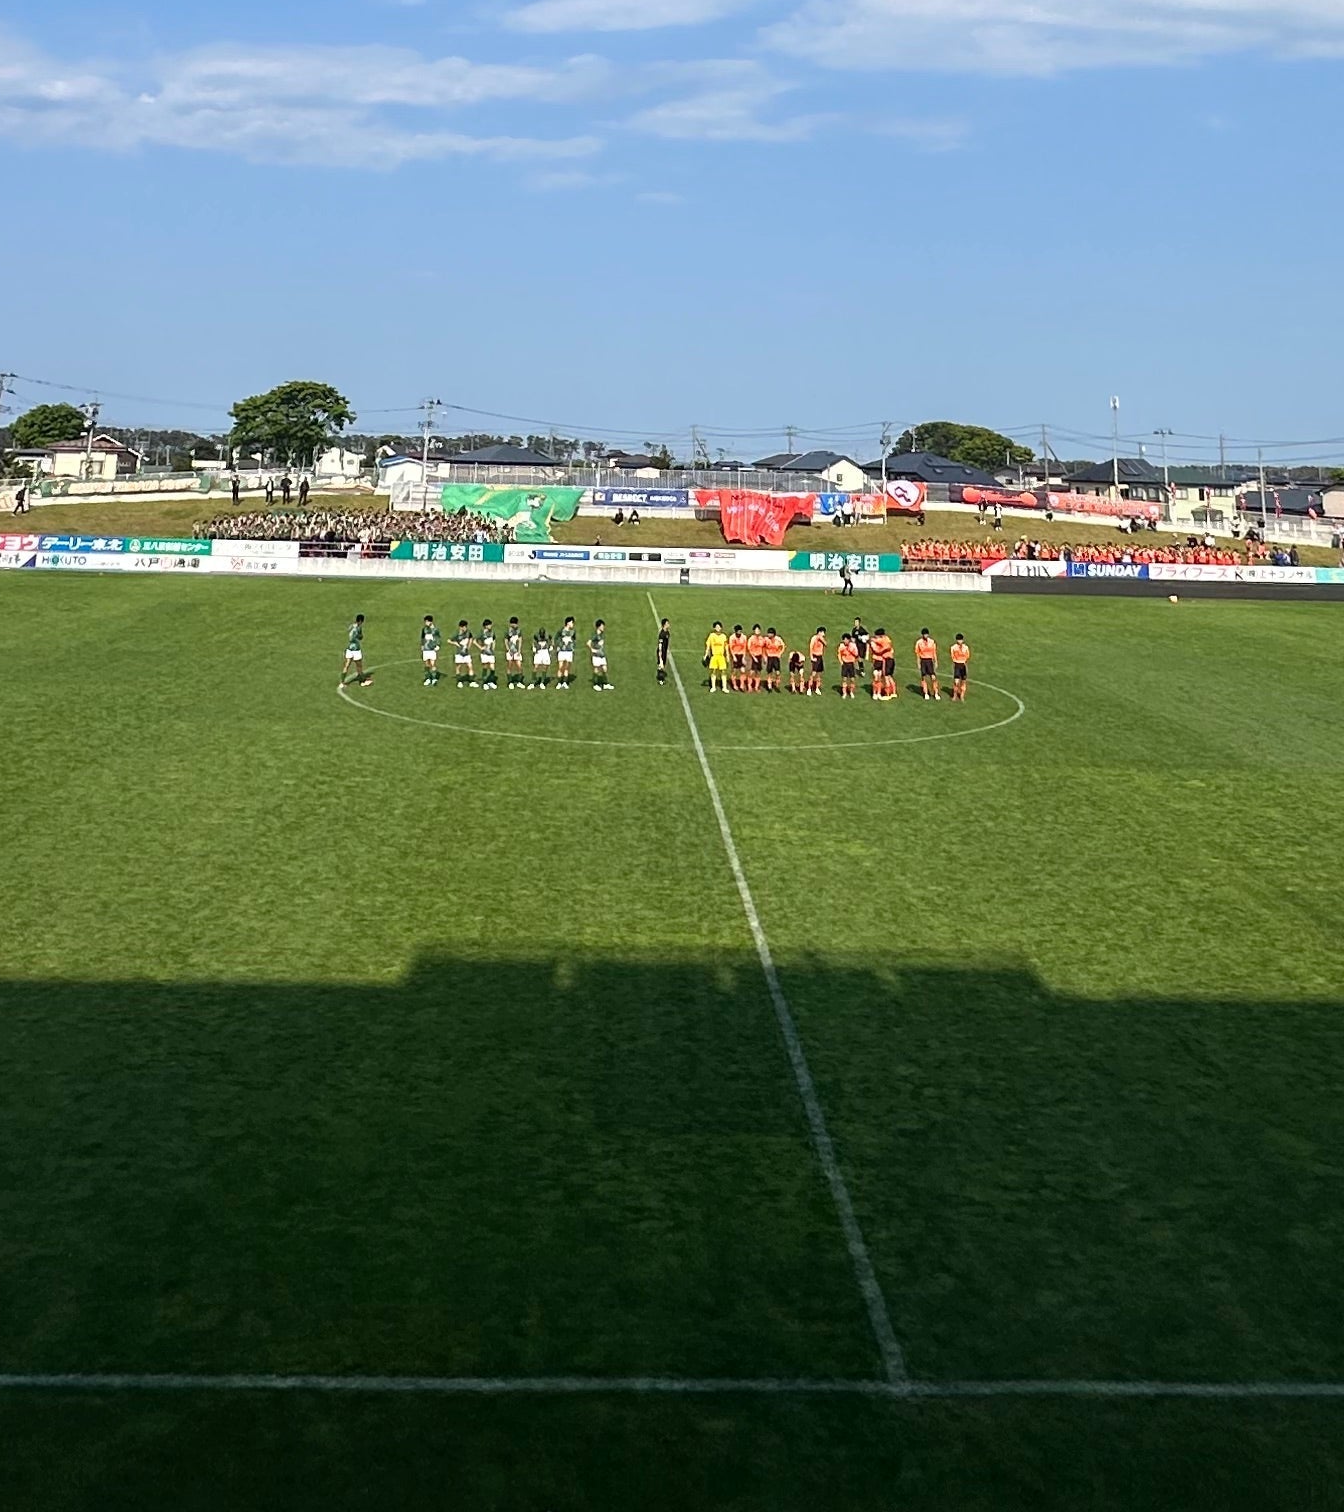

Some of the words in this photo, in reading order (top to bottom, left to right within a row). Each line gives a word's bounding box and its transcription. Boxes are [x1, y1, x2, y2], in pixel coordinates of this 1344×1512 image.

[412, 544, 485, 562] 明治安田
[809, 554, 881, 571] 明治安田
[1087, 564, 1142, 578] SUNDAY
